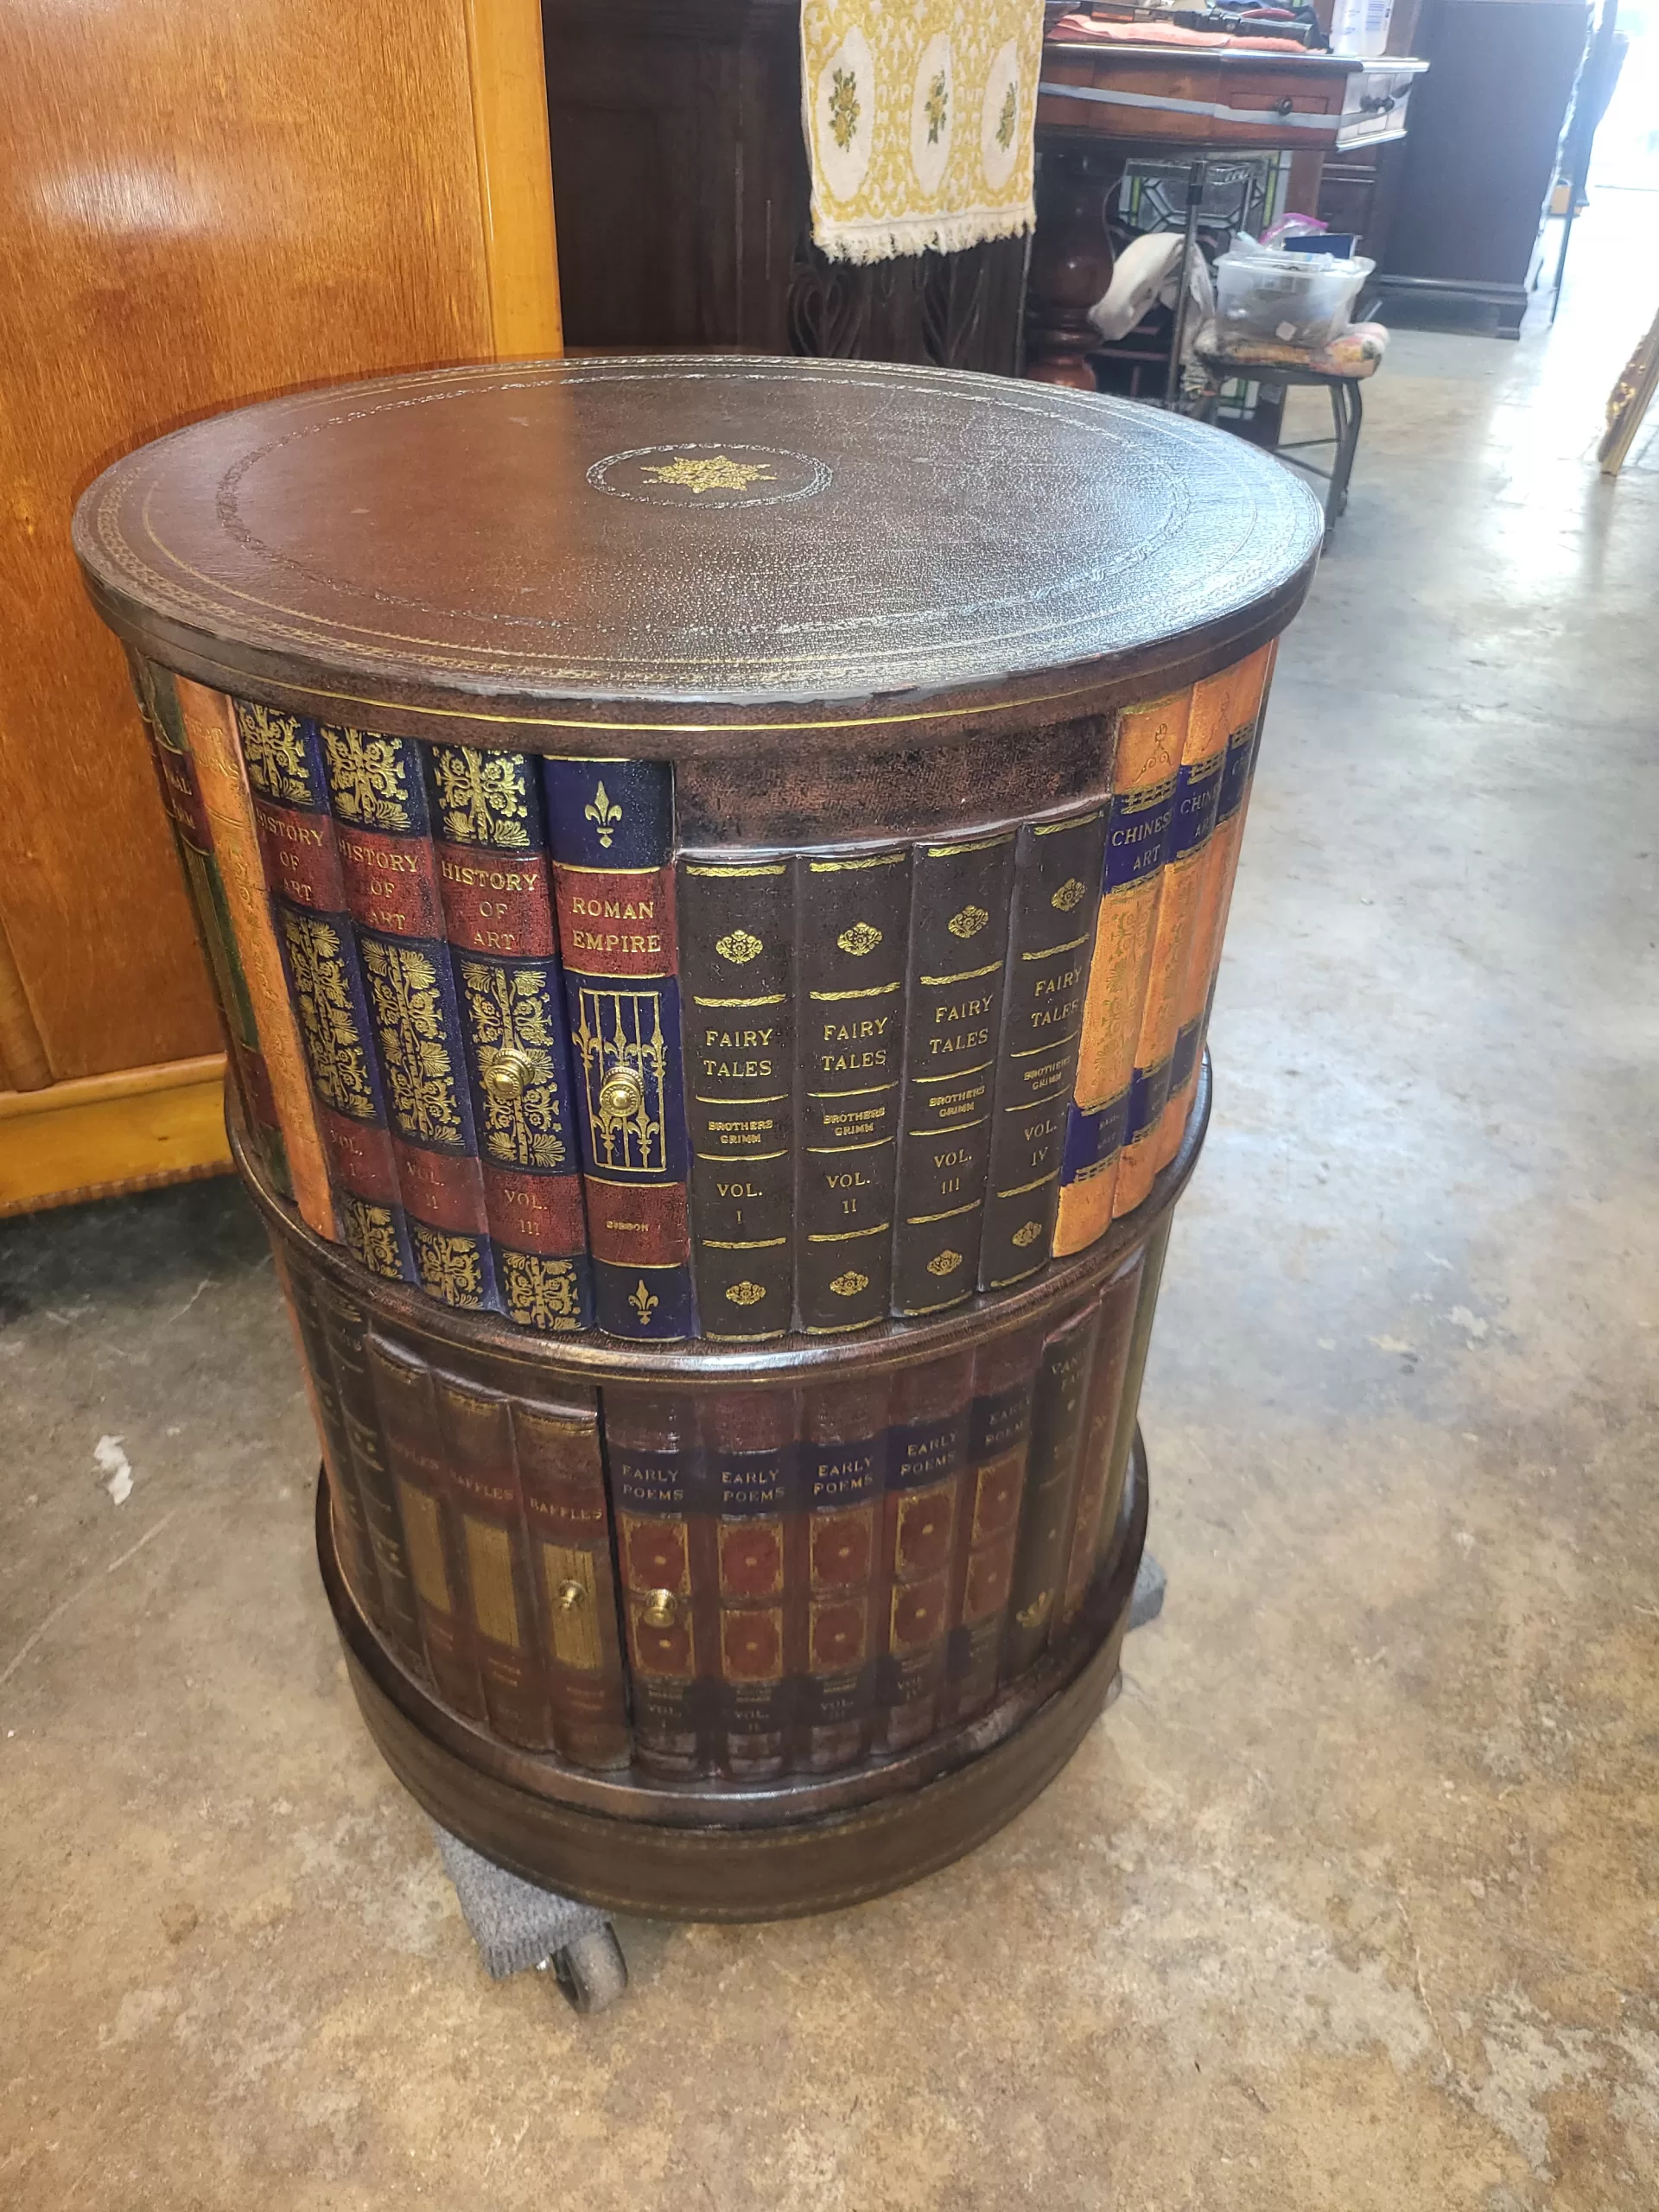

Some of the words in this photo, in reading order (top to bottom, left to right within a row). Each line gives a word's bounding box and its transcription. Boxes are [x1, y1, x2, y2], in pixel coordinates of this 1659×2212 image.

[257, 809, 323, 847] HISTORY
[280, 851, 299, 871] OF
[339, 836, 419, 873] HISTORY
[1133, 844, 1161, 871] ART
[442, 861, 538, 891] HISTORY
[284, 878, 313, 901] ART
[371, 880, 395, 899] OF
[480, 901, 508, 918] OF
[572, 896, 654, 919] ROMAN
[370, 910, 406, 931] ART
[474, 931, 516, 951] ART
[572, 930, 661, 953] EMPIRE
[1034, 965, 1083, 997] FAIRY
[935, 995, 993, 1023] FAIRY
[705, 1028, 773, 1046] FAIRY
[823, 1017, 888, 1040] FAIRY
[929, 1027, 989, 1054] TALES
[703, 1060, 772, 1077] TALES
[821, 1049, 887, 1071] TALES
[928, 1084, 985, 1107] BROTHERS
[823, 1107, 886, 1125] BROTHERS
[939, 1102, 975, 1118] GRIMM
[708, 1120, 773, 1131] BROTHERS
[834, 1122, 874, 1136] GRIMM
[1024, 1119, 1058, 1141] VOL.
[720, 1134, 761, 1144] GRIMM
[933, 1148, 973, 1168] VOL.
[1031, 1147, 1050, 1166] IV
[825, 1172, 871, 1188] VOL.
[941, 1177, 960, 1195] III
[504, 1189, 548, 1210] VOL.
[716, 1183, 763, 1198] VOL.
[842, 1198, 857, 1214] II
[736, 1210, 742, 1224] I
[520, 1219, 540, 1236] III
[907, 1431, 957, 1457] EARLY
[818, 1455, 874, 1477] EARLY
[900, 1450, 956, 1476] POEMS
[622, 1464, 678, 1483] EARLY
[721, 1469, 779, 1484] EARLY
[623, 1484, 684, 1501] POEMS
[723, 1487, 785, 1503] POEMS
[813, 1474, 873, 1496] POEMS
